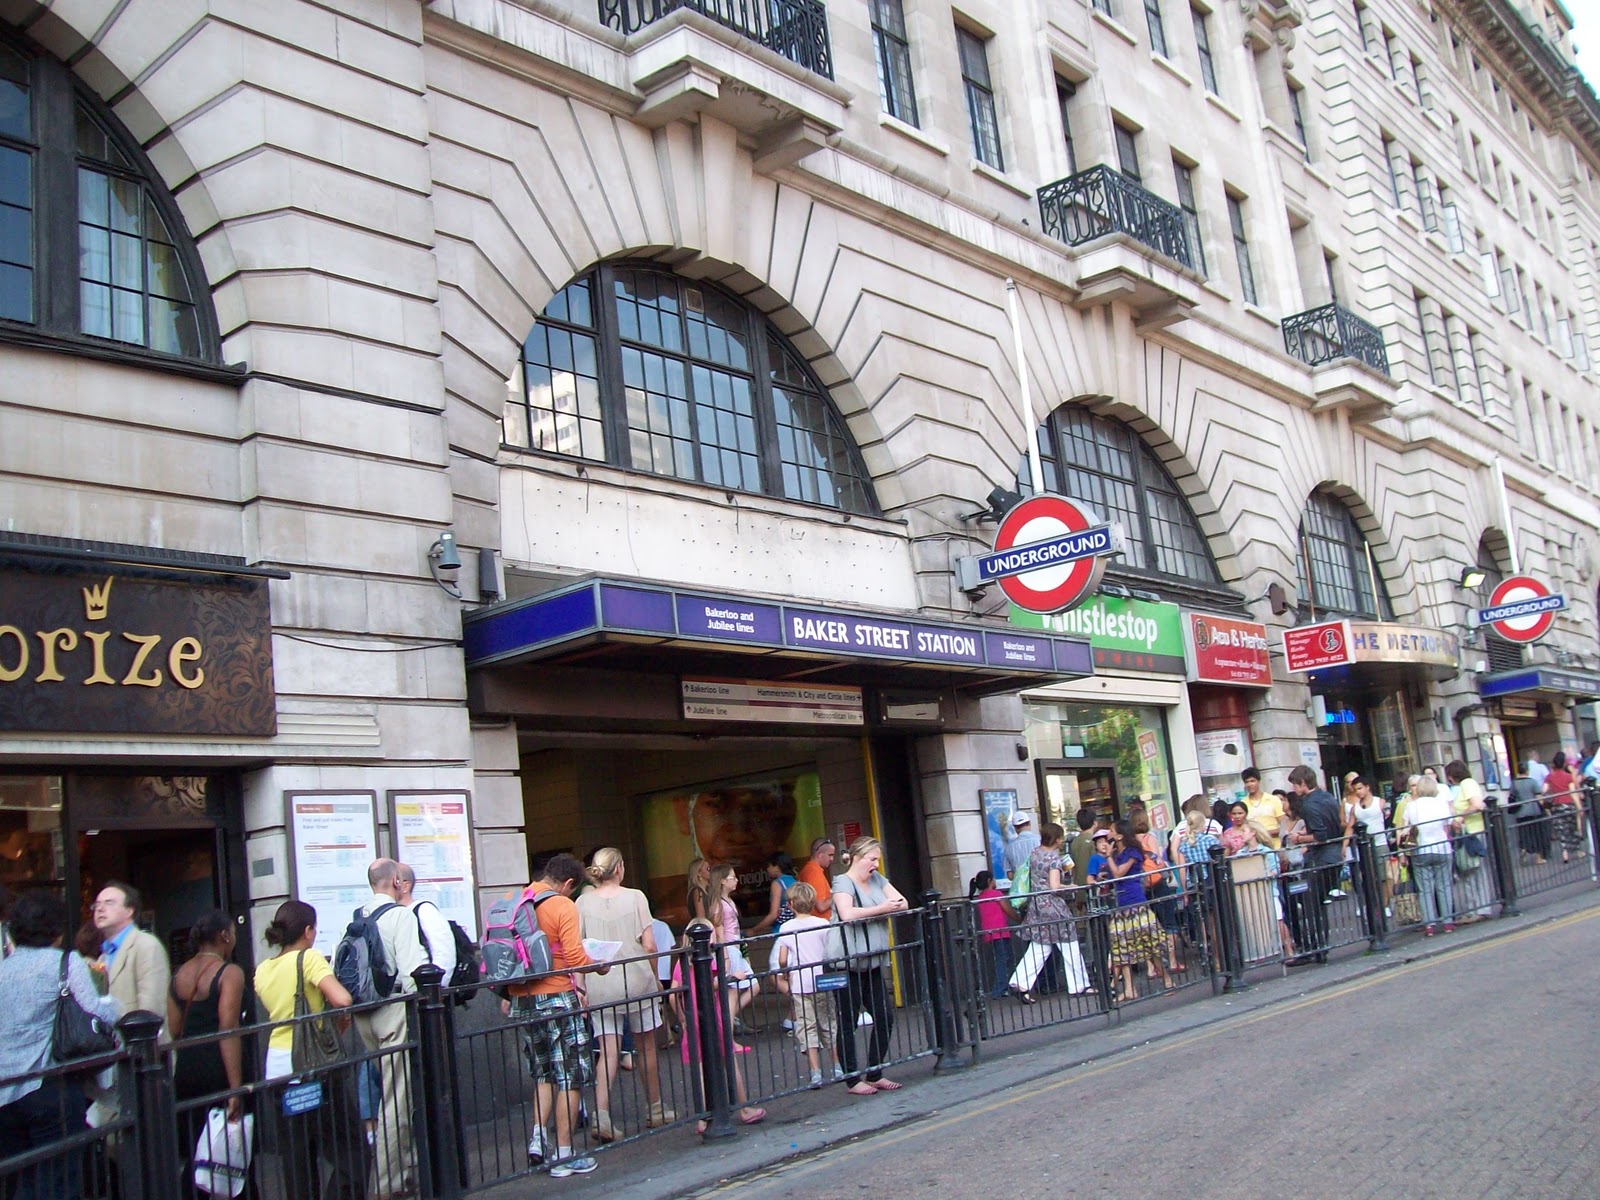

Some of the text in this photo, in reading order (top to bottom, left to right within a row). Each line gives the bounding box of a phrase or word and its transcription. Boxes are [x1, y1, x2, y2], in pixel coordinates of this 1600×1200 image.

[987, 533, 1107, 574] UNDERGROUND
[705, 606, 754, 621] Bakerloo and
[1482, 598, 1561, 620] UNDERGROUND
[707, 619, 755, 633] Jubilee lines
[793, 617, 976, 656] BAKER STREET STATION
[1003, 641, 1025, 650] Bakerloo
[690, 684, 717, 694] Bakerloo
[718, 687, 730, 695] line
[757, 688, 797, 698] Hammersmith
[804, 691, 815, 700] City
[816, 692, 826, 700] and
[827, 692, 842, 701] Circle
[843, 694, 856, 702] lines
[692, 706, 715, 716] Jubilee
[716, 707, 728, 715] line
[813, 711, 847, 720] Metropolitan
